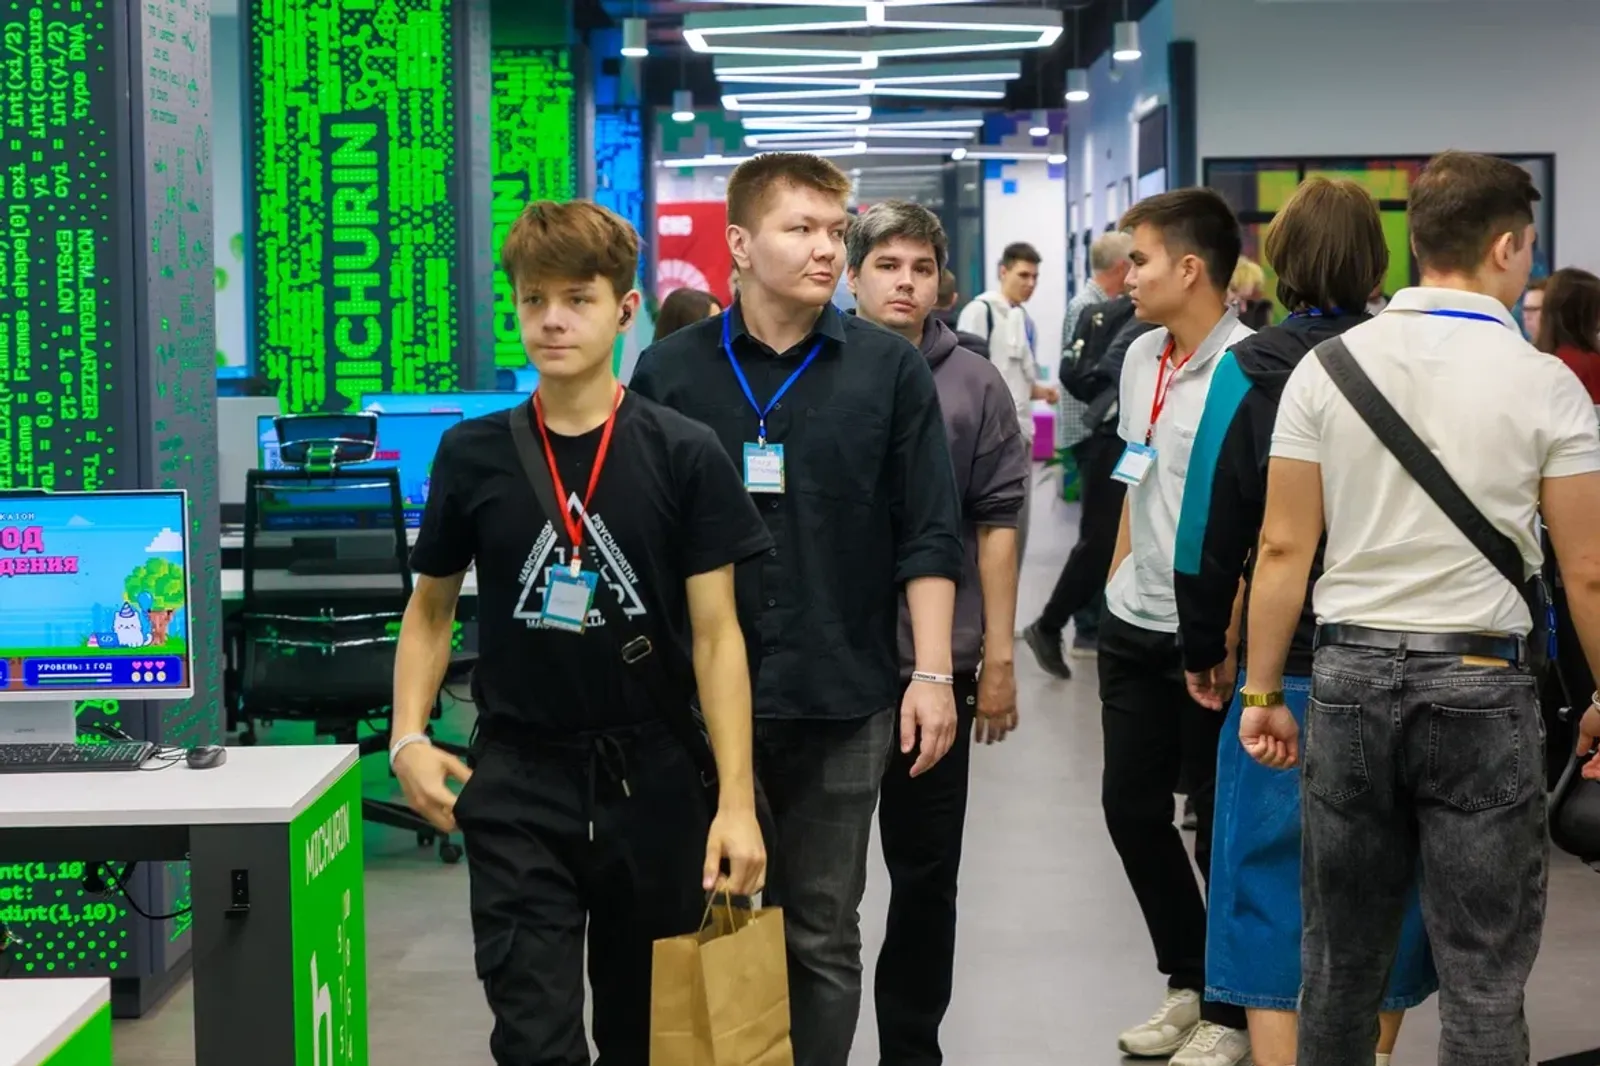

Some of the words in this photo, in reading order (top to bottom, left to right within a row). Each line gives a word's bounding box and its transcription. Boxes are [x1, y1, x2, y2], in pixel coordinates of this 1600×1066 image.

[68, 23, 86, 60] DNA
[72, 71, 91, 119] type
[56, 229, 75, 313] EPSILON
[78, 229, 99, 419] NORM_REGULARIZER
[592, 513, 639, 584] PSYCHOPATHY
[306, 801, 351, 885] MICHURIN
